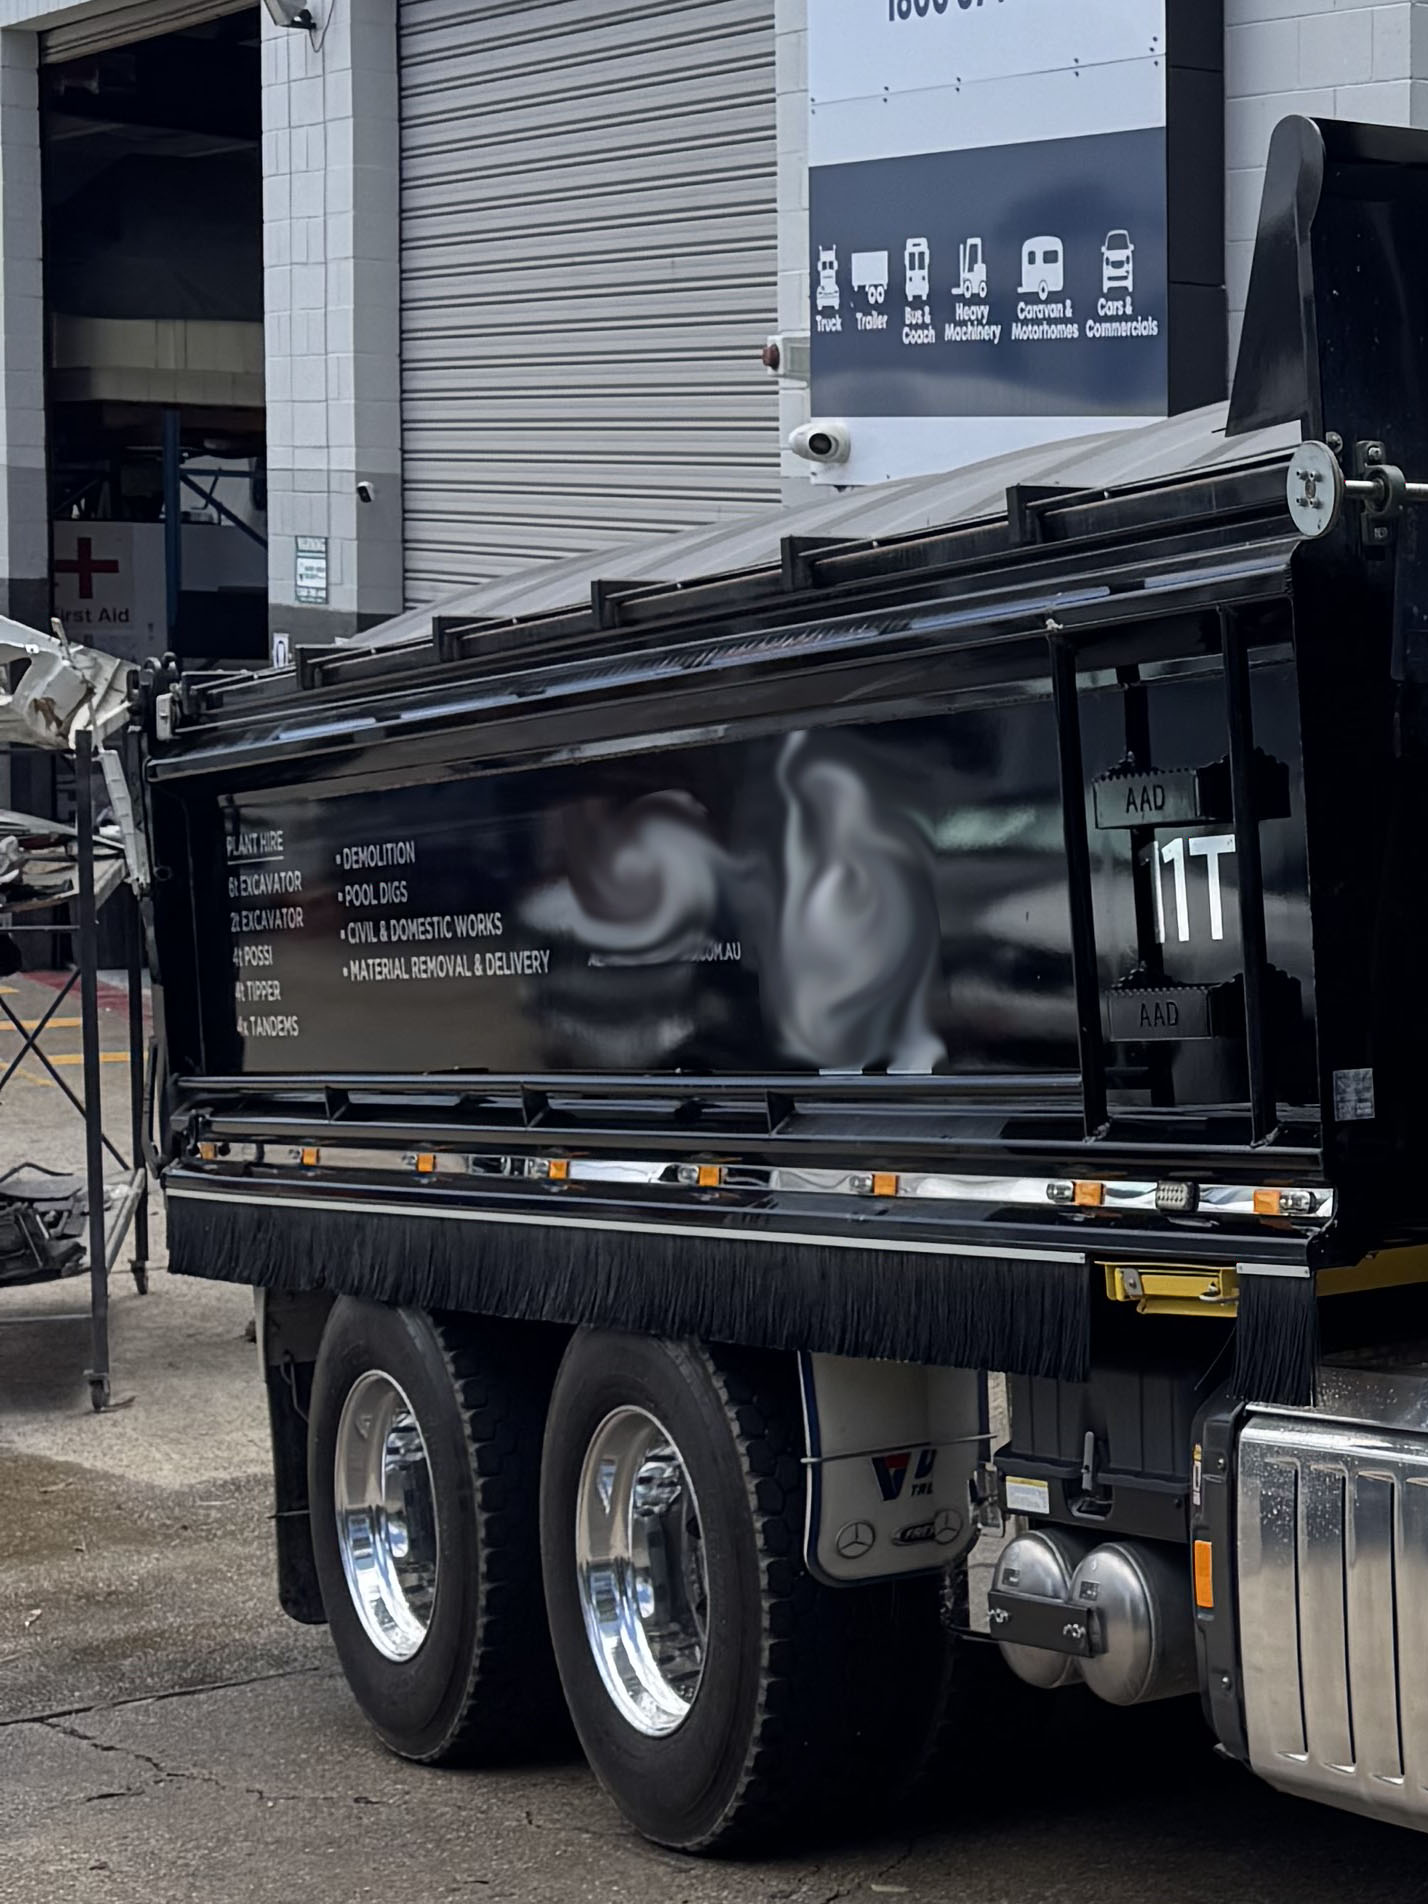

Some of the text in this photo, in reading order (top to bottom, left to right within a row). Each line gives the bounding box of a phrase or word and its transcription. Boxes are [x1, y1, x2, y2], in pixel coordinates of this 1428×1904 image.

[904, 305, 931, 325] Bus &
[955, 302, 989, 325] Heavy
[1017, 299, 1072, 320] Caravan &
[1097, 295, 1132, 316] Cars &
[816, 314, 842, 332] Truck
[856, 310, 888, 330] Trailer
[1011, 321, 1079, 340] Motorhomes
[1085, 316, 1158, 338] Commercials
[902, 326, 936, 344] Coach
[944, 321, 1001, 344] Machinery
[98, 608, 130, 624] Aid
[226, 830, 283, 856] PLANT HIRE
[343, 840, 416, 870] DEMOLITION
[228, 870, 302, 897] 6t EXCAVATOR
[345, 880, 408, 907] POOL DIGS
[241, 907, 304, 932] EXCAVATOR
[347, 912, 503, 944] CIVIL & DOMESTIC WORKS
[244, 945, 273, 966] POSSI
[350, 949, 550, 982] MATERIAL REMOVAL & DELIVERY
[246, 980, 281, 1001] TIPPER
[249, 1015, 299, 1036] TANDEMS
